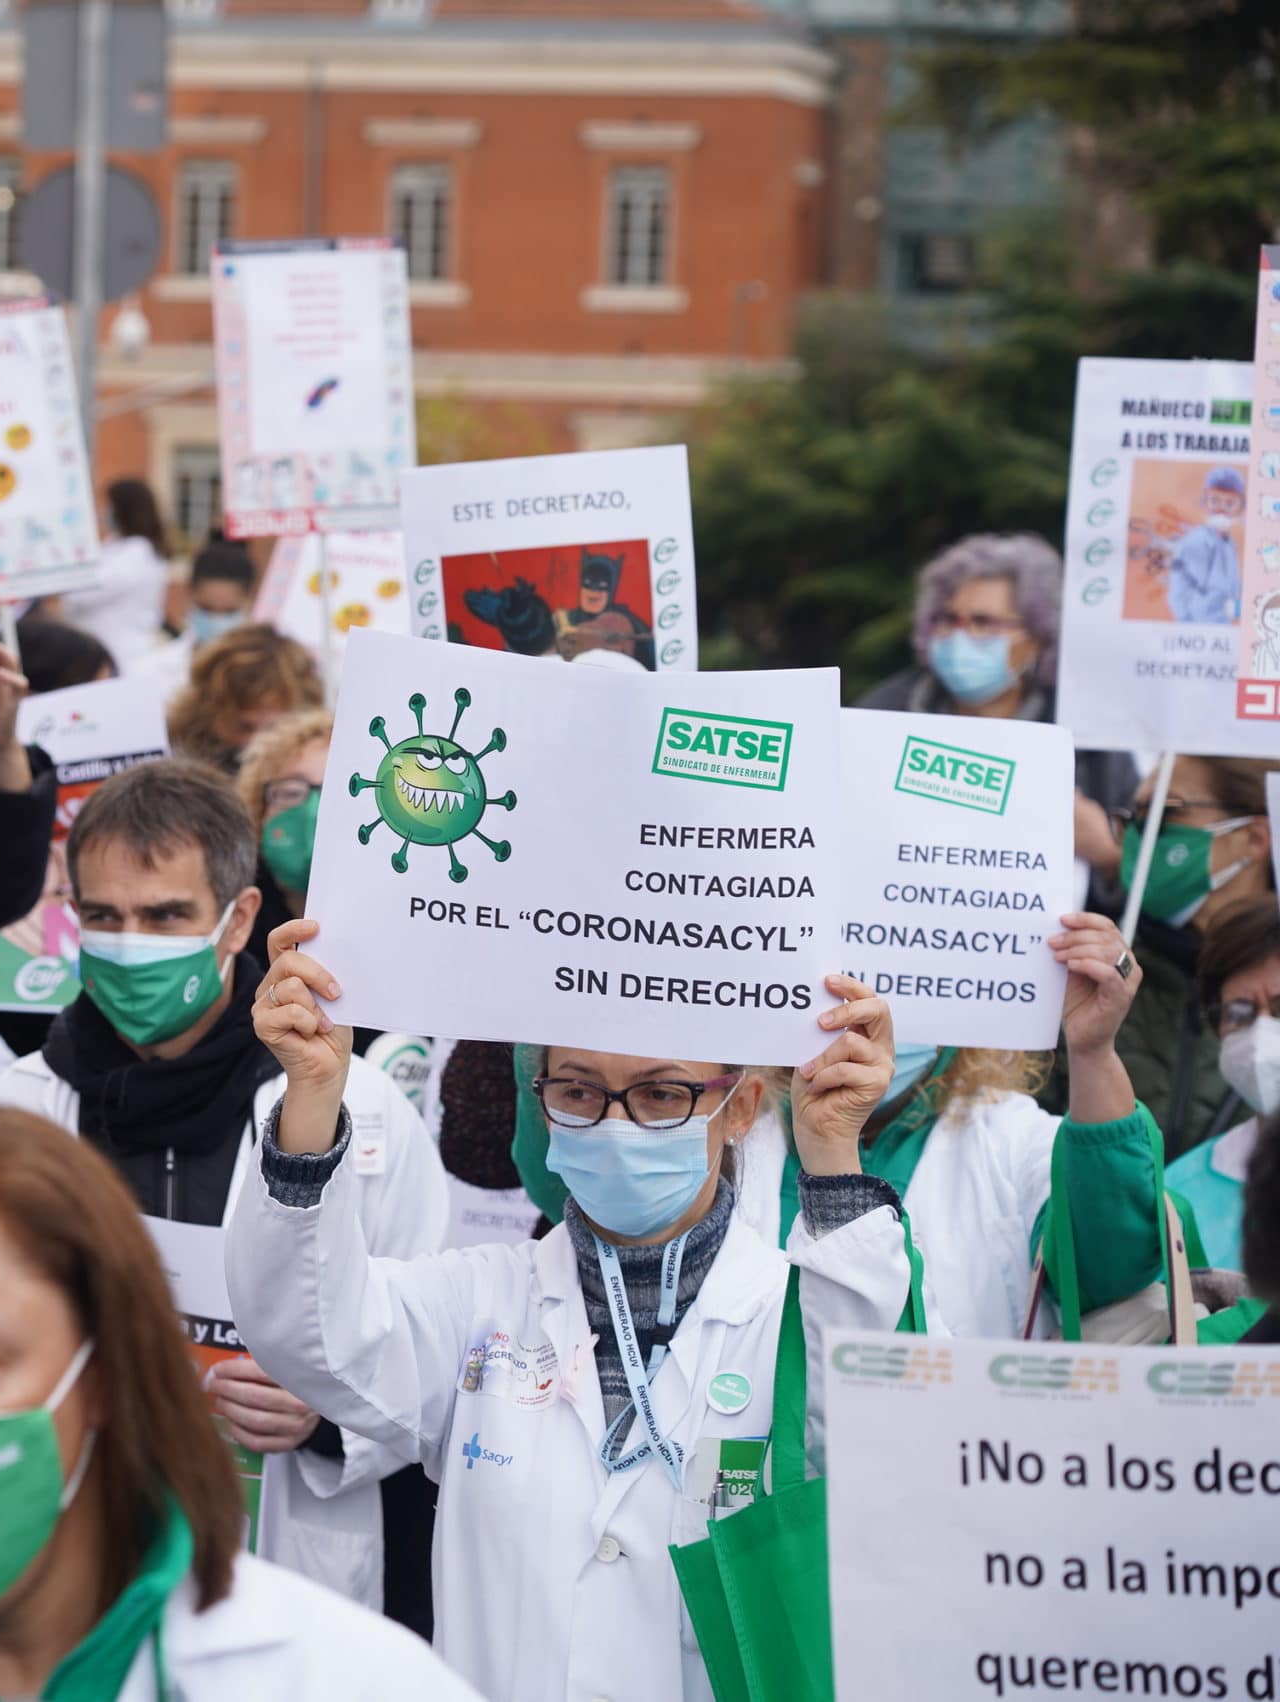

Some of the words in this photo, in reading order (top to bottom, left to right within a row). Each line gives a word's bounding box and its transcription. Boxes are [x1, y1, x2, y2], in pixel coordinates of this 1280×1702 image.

[1136, 432, 1168, 450] LOS
[1174, 433, 1252, 453] TRABAJA
[452, 502, 495, 523] ESTE
[506, 490, 632, 518] DECRETAZO,
[666, 721, 783, 764] SATSE
[663, 756, 709, 772] SINDICATO
[710, 763, 721, 774] DE
[723, 765, 777, 782] ENFERMERÍA
[907, 748, 1006, 792] SATSE
[640, 823, 816, 850] ENFERMERA
[897, 844, 1048, 872] ENFERMERA
[624, 870, 816, 898] CONTAGIADA
[883, 883, 1046, 912] CONTAGIADA
[409, 896, 467, 925] POR
[475, 905, 510, 929] EL
[554, 966, 609, 996] SIN
[619, 972, 812, 1010] DERECHOS
[875, 973, 1037, 1003] DERECHOS
[194, 1324, 209, 1343] y
[213, 1323, 245, 1346] Le
[609, 1275, 633, 1343] ENFERMERA/O
[625, 1342, 640, 1368] HCUV
[831, 1341, 953, 1384] CESM
[988, 1353, 1119, 1393] CESM
[636, 1385, 660, 1443] ENFERMERA/O
[482, 1448, 514, 1466] Sacyl
[959, 1439, 1044, 1487] ¡No
[1063, 1452, 1088, 1488] a
[1106, 1443, 1177, 1492] los
[1193, 1447, 1280, 1496] dec
[723, 1469, 760, 1480] SATSE
[985, 1551, 1044, 1589] no
[1062, 1555, 1088, 1590] a
[1106, 1546, 1148, 1594] la
[1164, 1550, 1280, 1609] impo
[975, 1650, 1229, 1699] queremos
